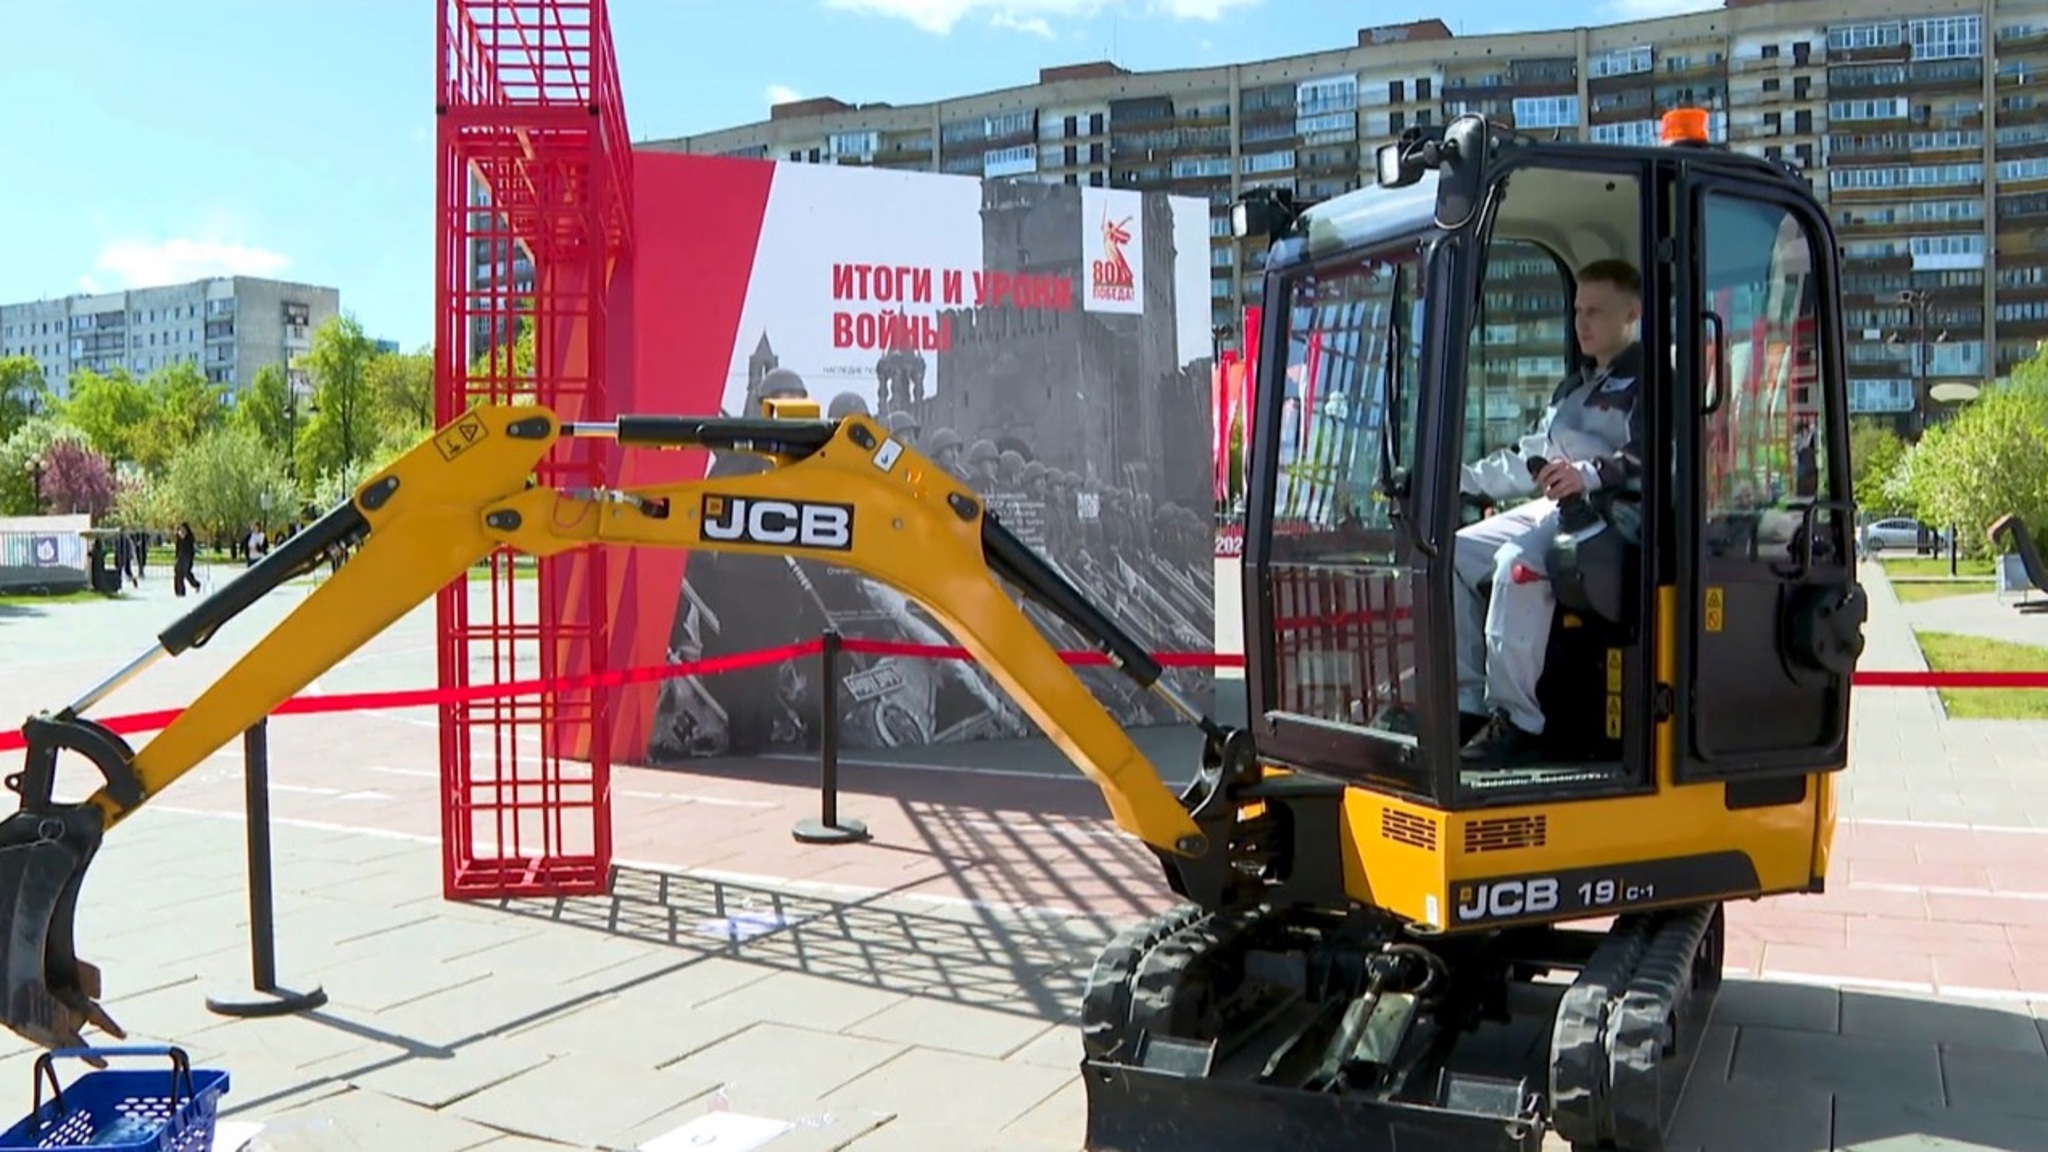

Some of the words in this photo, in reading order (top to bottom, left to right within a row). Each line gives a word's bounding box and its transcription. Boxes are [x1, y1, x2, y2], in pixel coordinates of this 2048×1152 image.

[832, 263, 932, 303] ИТОГИ
[942, 270, 963, 304] И
[973, 270, 1073, 310] УРОКИ
[833, 310, 953, 352] ВОЙНЫ
[704, 498, 849, 547] JCB
[1458, 877, 1559, 920] JCB
[1578, 879, 1615, 906] 19
